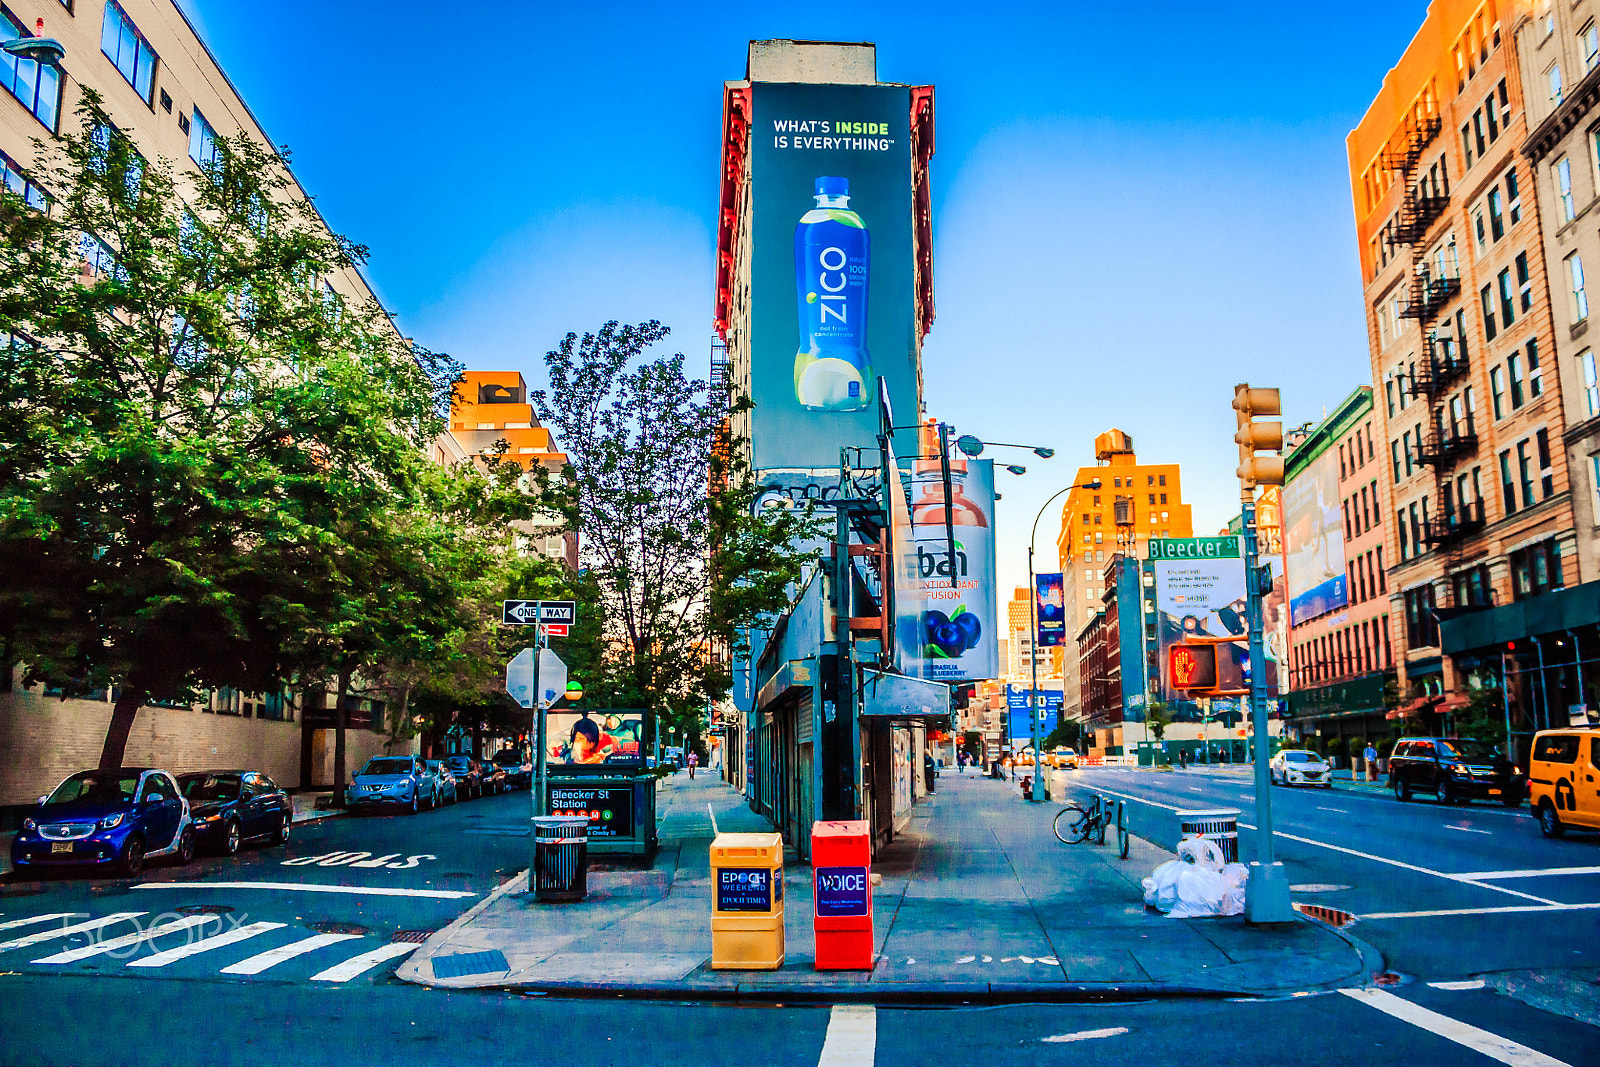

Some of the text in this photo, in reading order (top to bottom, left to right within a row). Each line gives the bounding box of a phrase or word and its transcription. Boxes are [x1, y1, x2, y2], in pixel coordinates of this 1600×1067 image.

[773, 120, 889, 135] WHAT'S INSIDE
[774, 136, 788, 149] IS
[1150, 538, 1238, 558] Bleecker St
[517, 608, 567, 617] ONE WAY
[552, 790, 609, 799] Bleecker St
[552, 799, 587, 808] Station
[279, 850, 438, 869] STOP
[722, 872, 766, 884] EPOCH
[821, 874, 865, 891] VOICE
